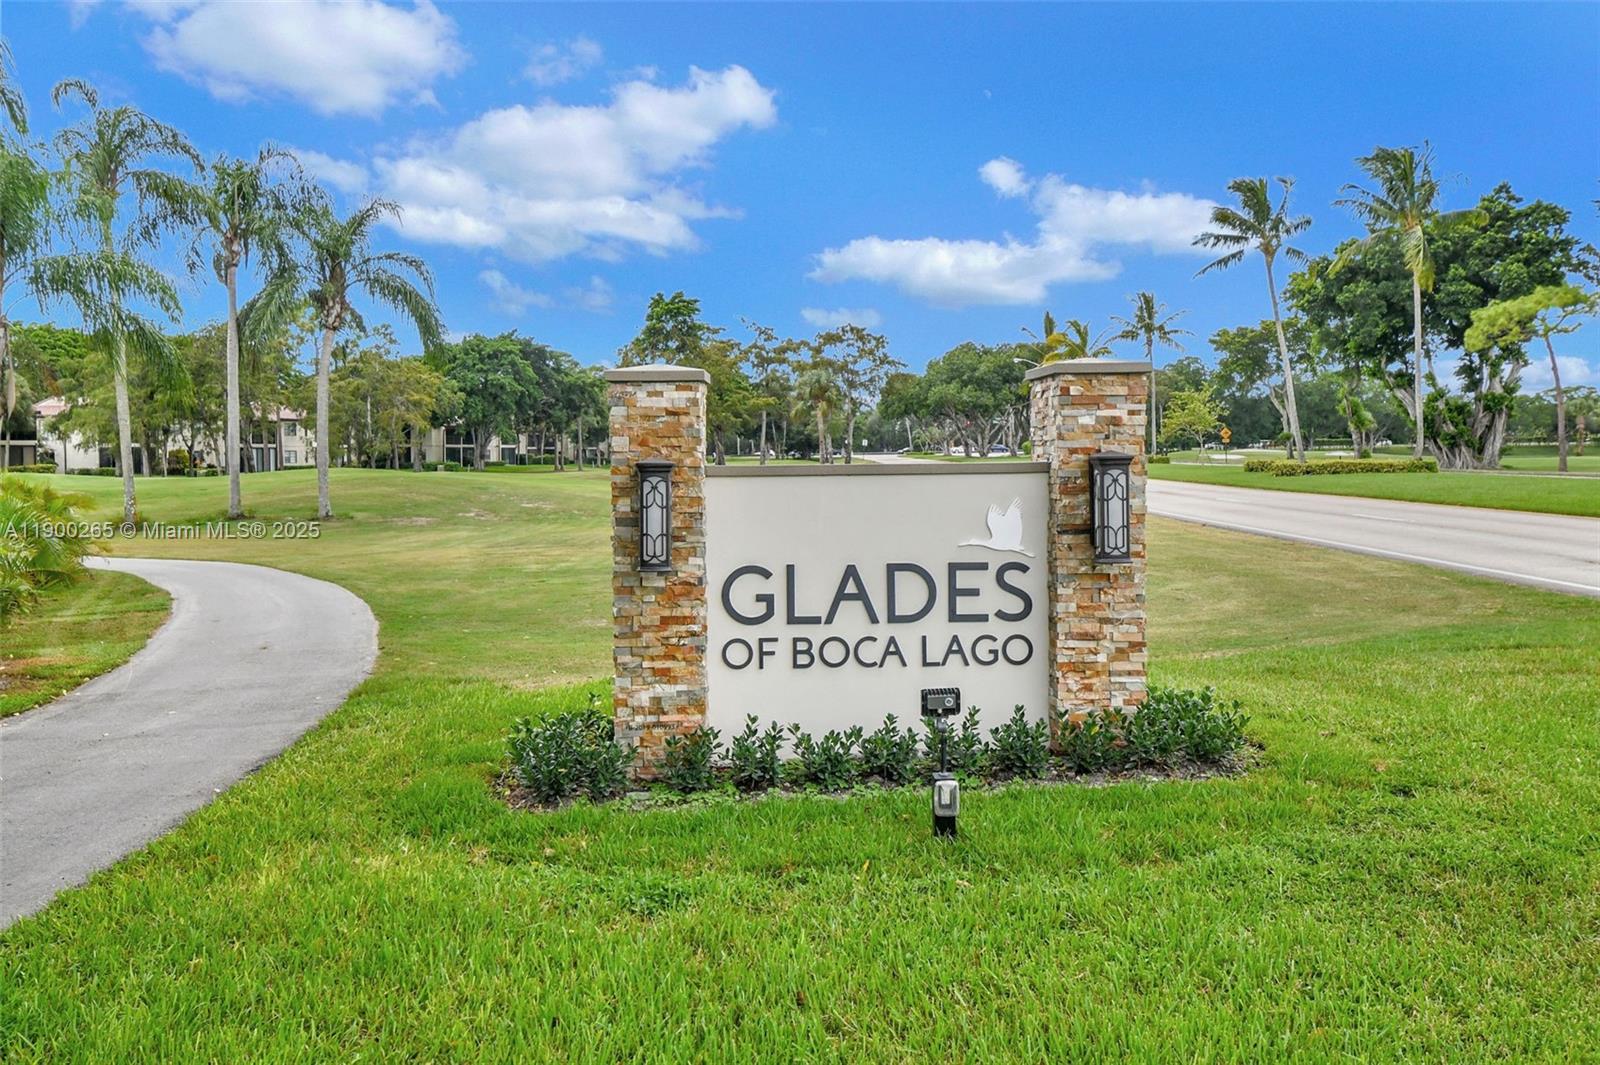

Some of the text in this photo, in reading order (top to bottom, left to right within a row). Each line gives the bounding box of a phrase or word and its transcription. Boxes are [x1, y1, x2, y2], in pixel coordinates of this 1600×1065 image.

[720, 561, 1034, 626] GLADES
[721, 634, 1034, 670] OF BOCA LAGO
